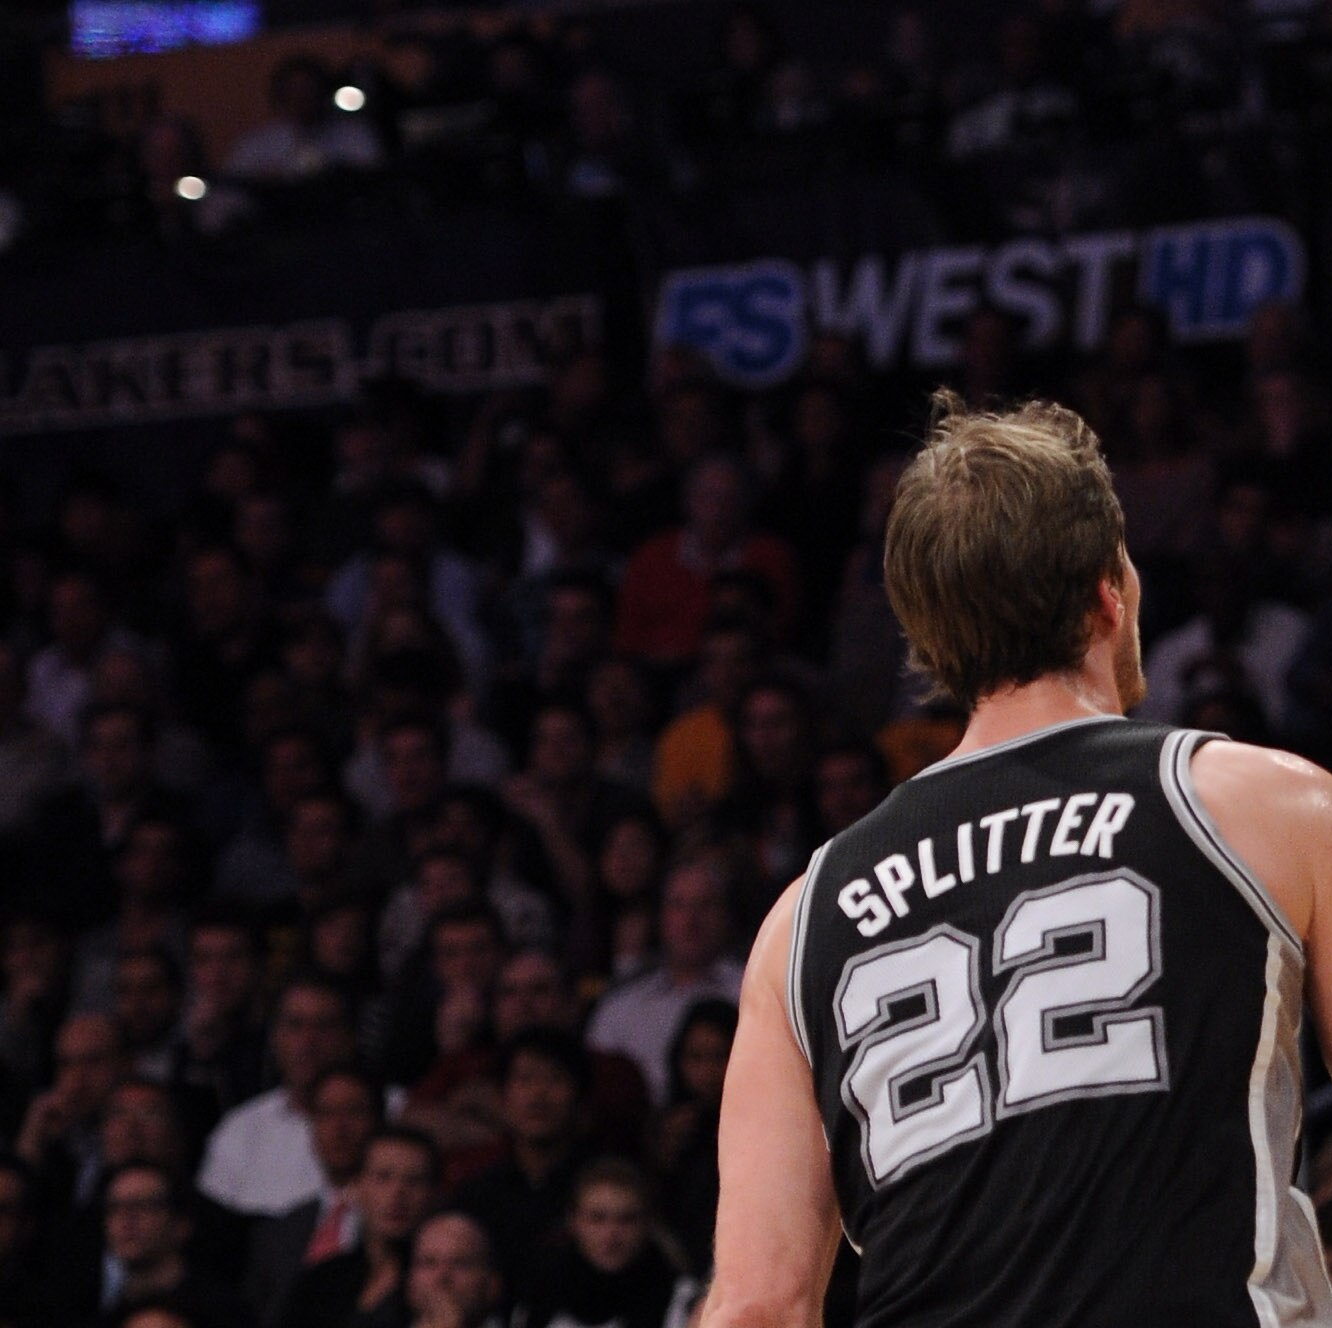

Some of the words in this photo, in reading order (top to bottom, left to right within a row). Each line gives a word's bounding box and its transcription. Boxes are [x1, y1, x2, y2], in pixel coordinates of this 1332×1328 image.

[804, 228, 1138, 370] WEST
[1140, 221, 1298, 337] HD
[837, 792, 1135, 938] SPLITTER
[833, 866, 1170, 1191] 22
